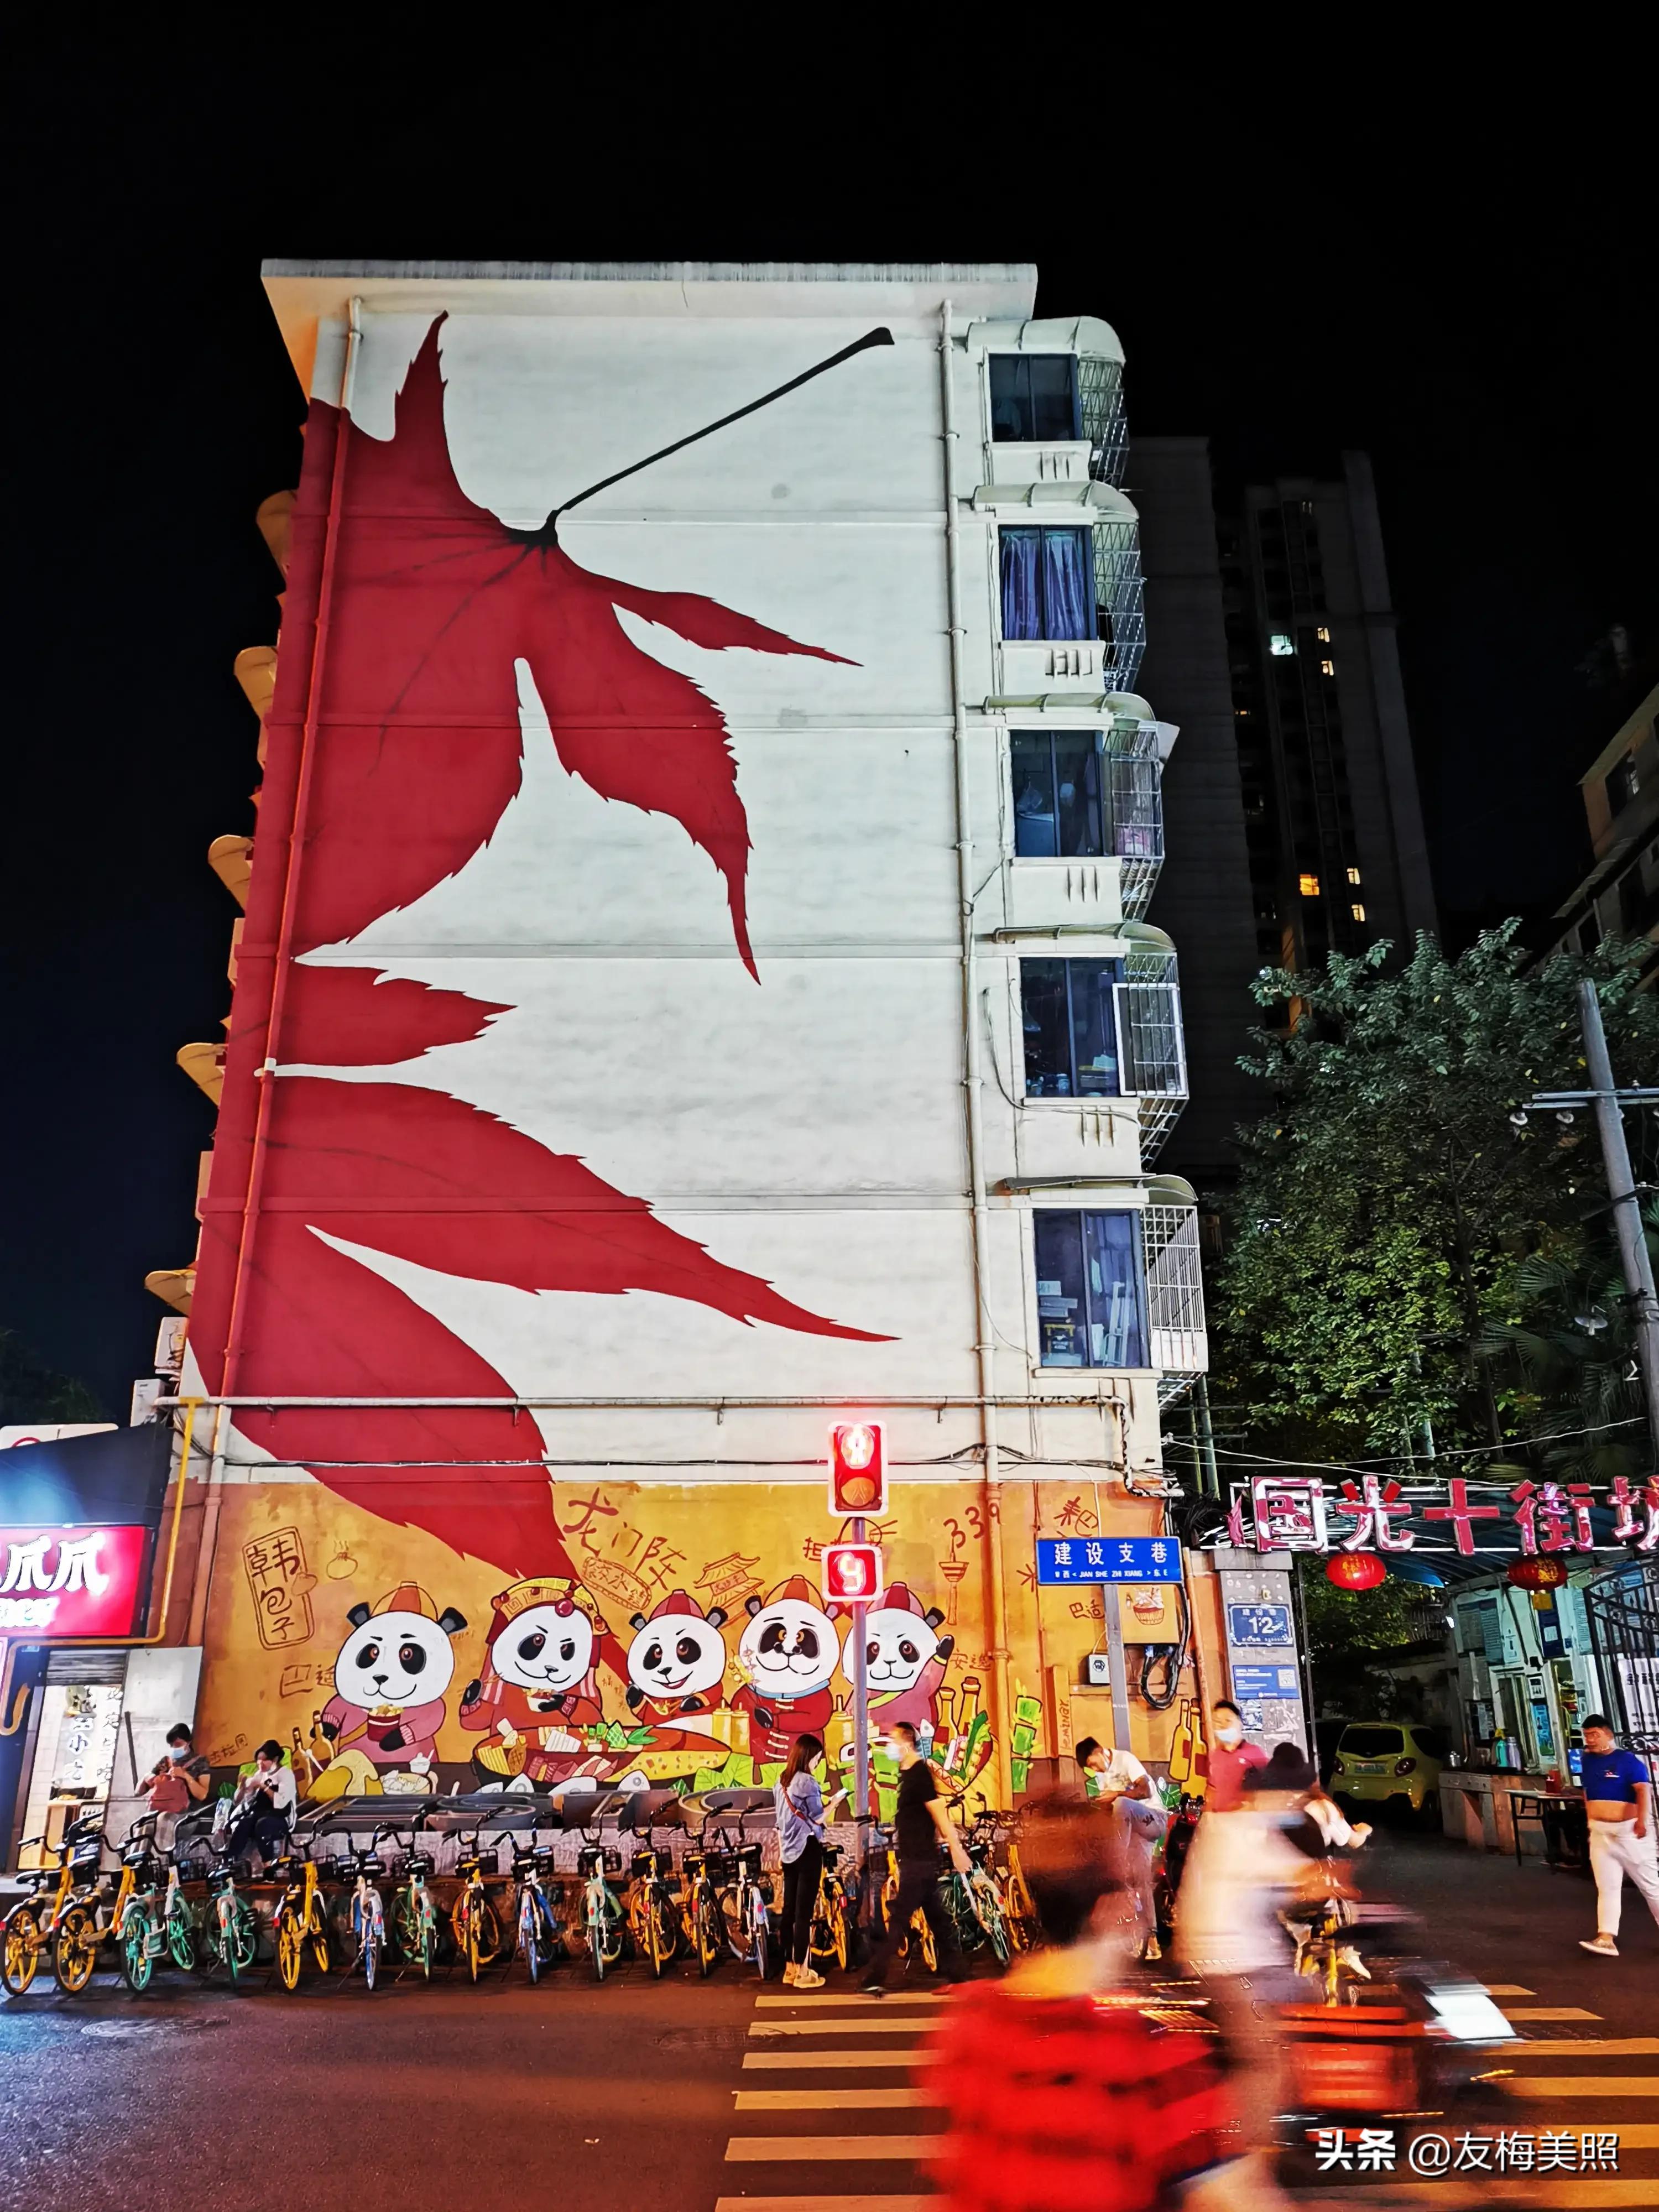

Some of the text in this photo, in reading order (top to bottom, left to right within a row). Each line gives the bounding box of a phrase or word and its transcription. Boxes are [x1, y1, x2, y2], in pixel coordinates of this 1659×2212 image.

[562, 1487, 687, 1590] 龙门阵
[943, 1503, 1003, 1548] 339
[1055, 1541, 1167, 1565] 建设支巷
[247, 1538, 300, 1641] 韩包子
[1248, 1616, 1274, 1634] 12
